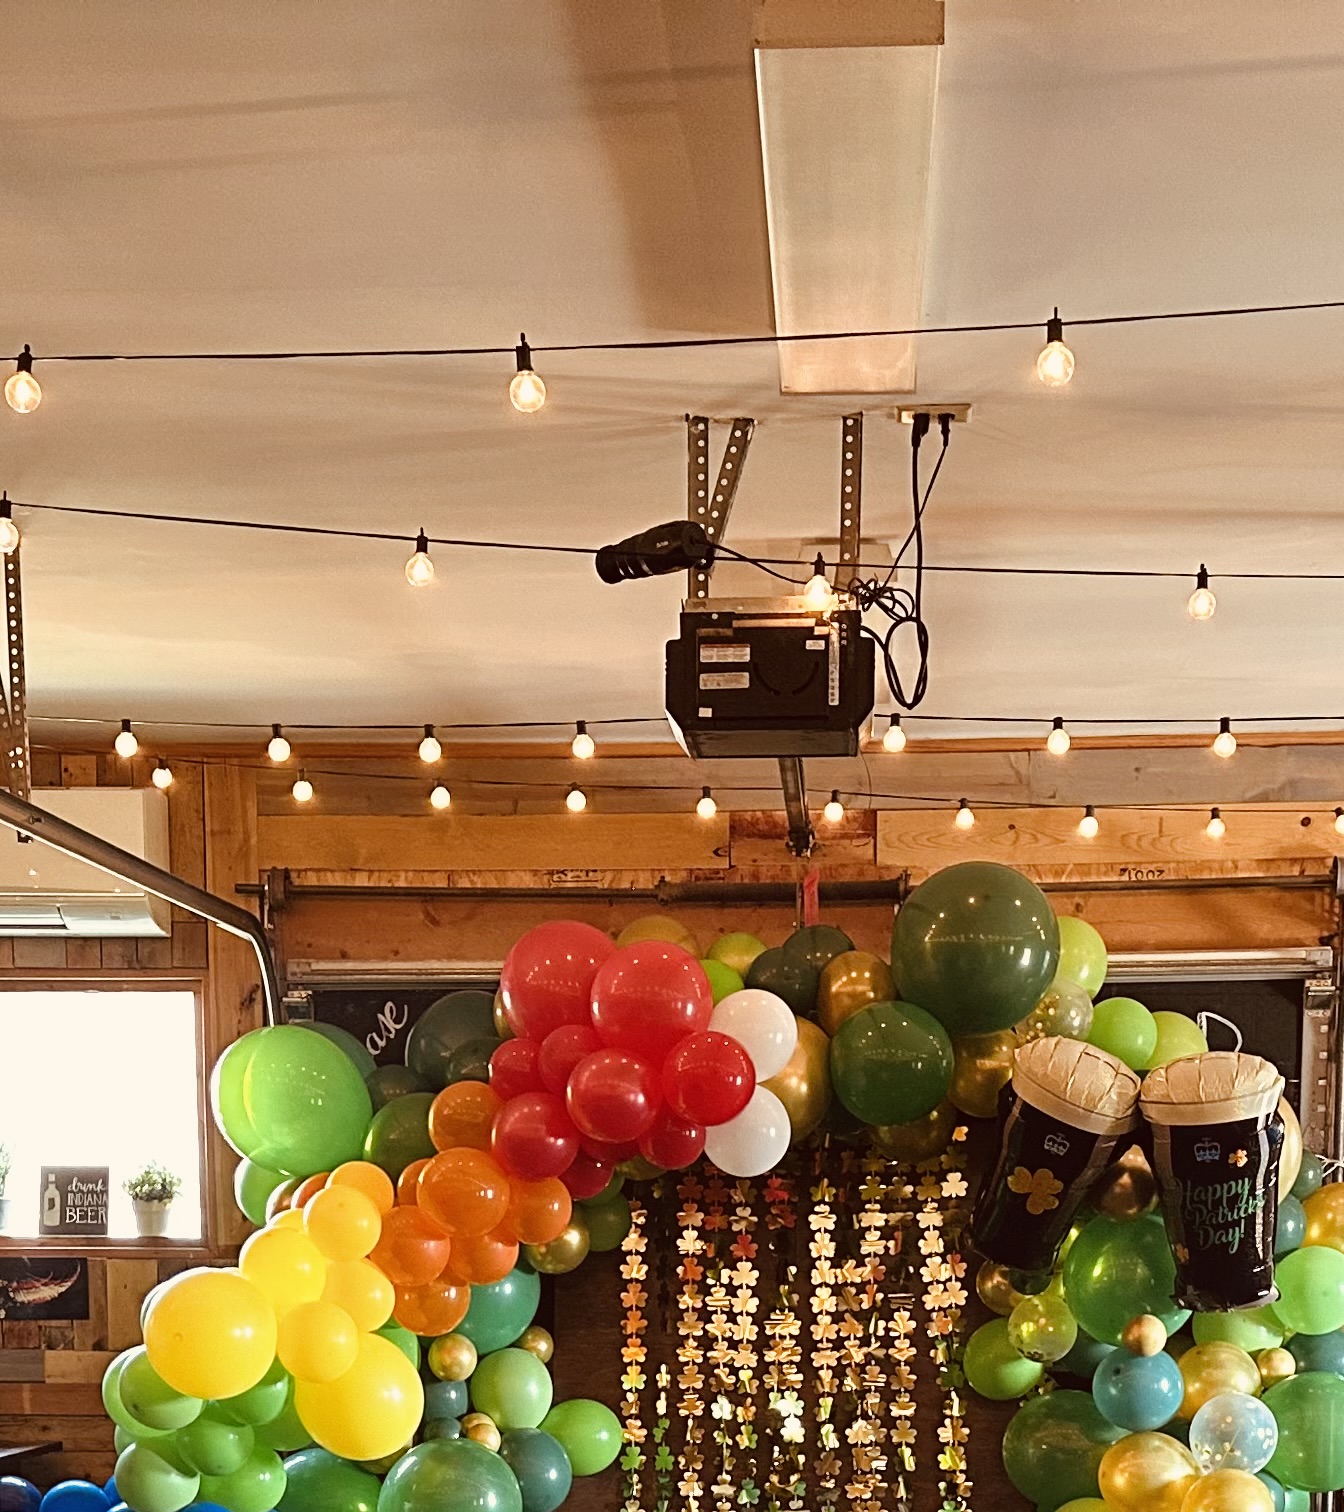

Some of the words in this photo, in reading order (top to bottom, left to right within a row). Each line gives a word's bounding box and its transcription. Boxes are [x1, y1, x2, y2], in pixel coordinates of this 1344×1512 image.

[67, 1176, 107, 1193] drink
[67, 1192, 108, 1206] INDIANA
[1178, 1177, 1253, 1211] Happy
[65, 1206, 107, 1224] BEER
[1196, 1219, 1245, 1254] Day!
